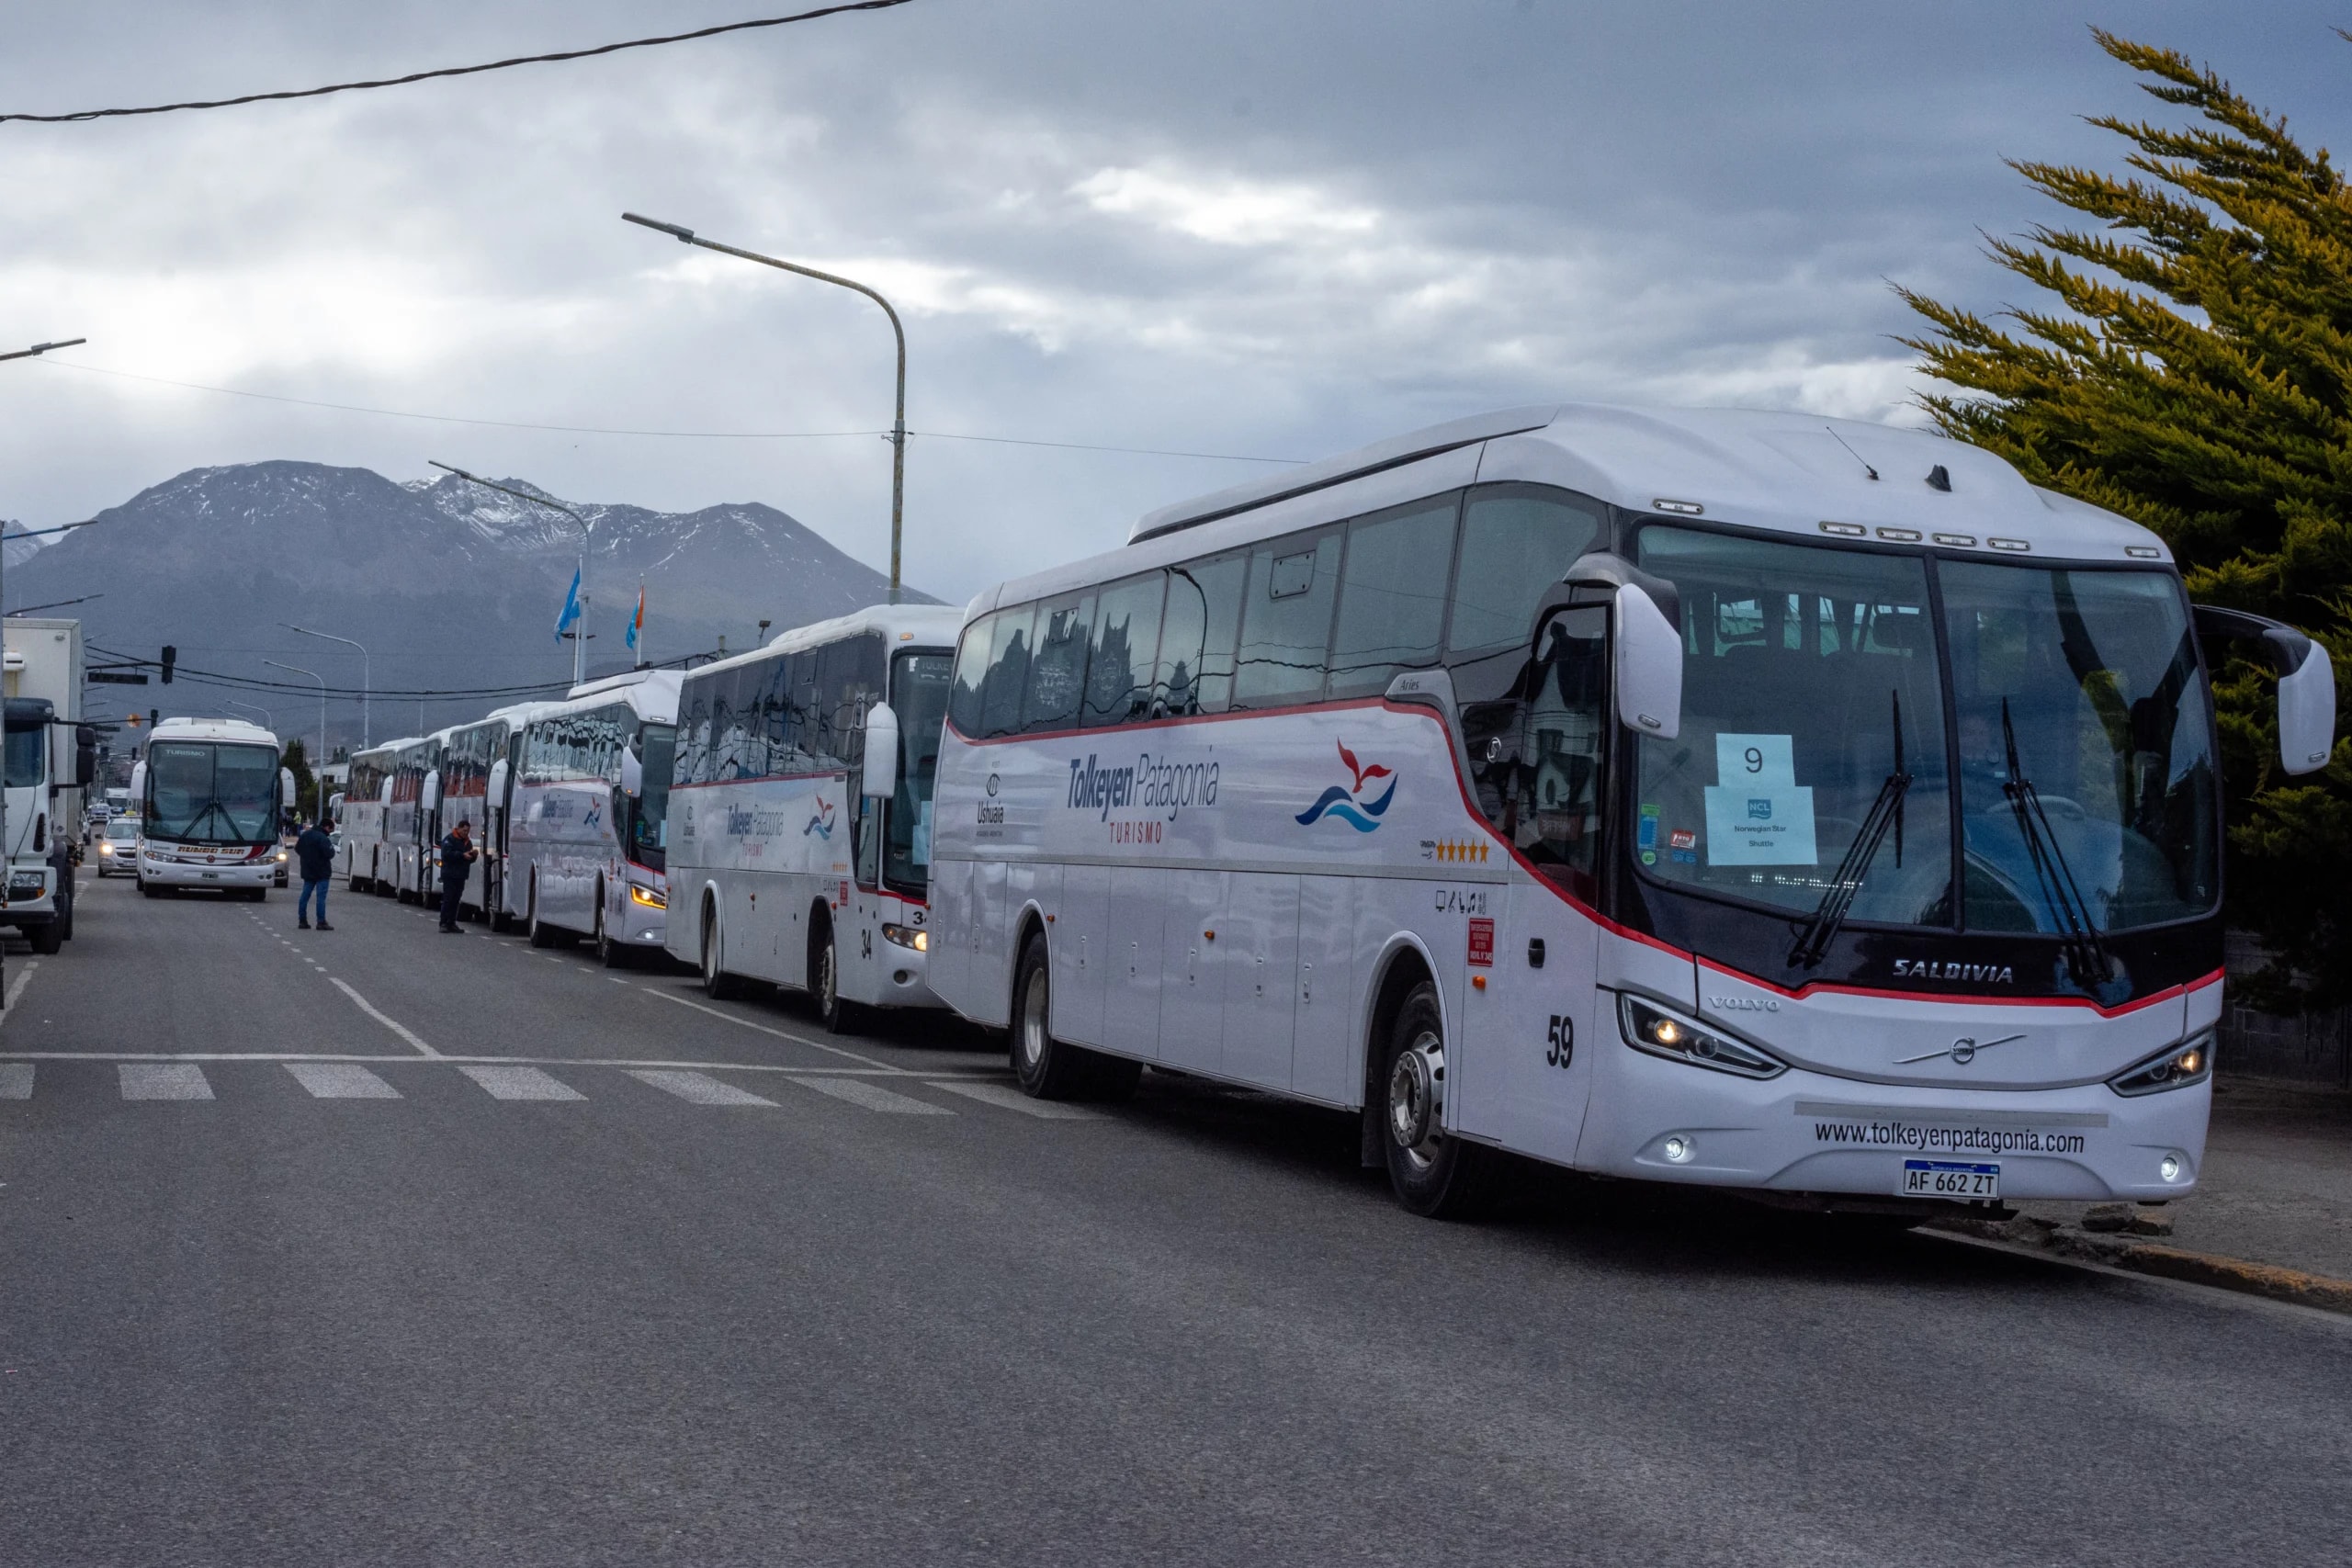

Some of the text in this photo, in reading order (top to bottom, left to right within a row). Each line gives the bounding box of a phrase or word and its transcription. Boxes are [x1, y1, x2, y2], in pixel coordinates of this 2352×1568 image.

[1400, 679, 1419, 691] Aries
[165, 749, 206, 757] TURISMO
[1745, 747, 1763, 773] 9
[1068, 745, 1219, 823] Tolkeyen Patagonia
[977, 800, 1004, 824] Ushuaia
[1749, 802, 1770, 811] NCL
[727, 803, 753, 843] Tolkeyen
[1109, 821, 1162, 844] TURISMO
[1735, 825, 1771, 833] Norwegian
[177, 846, 219, 854] RUMBO
[912, 910, 927, 926] 3
[861, 928, 872, 960] 34
[1893, 959, 2013, 984] SALDIVIA
[1708, 995, 1781, 1012] VOLVO
[1546, 1014, 1574, 1070] 59
[1815, 1122, 2086, 1154] www.tolkeyenpatagonia.com
[1908, 1171, 1995, 1194] AF 662 ZT
